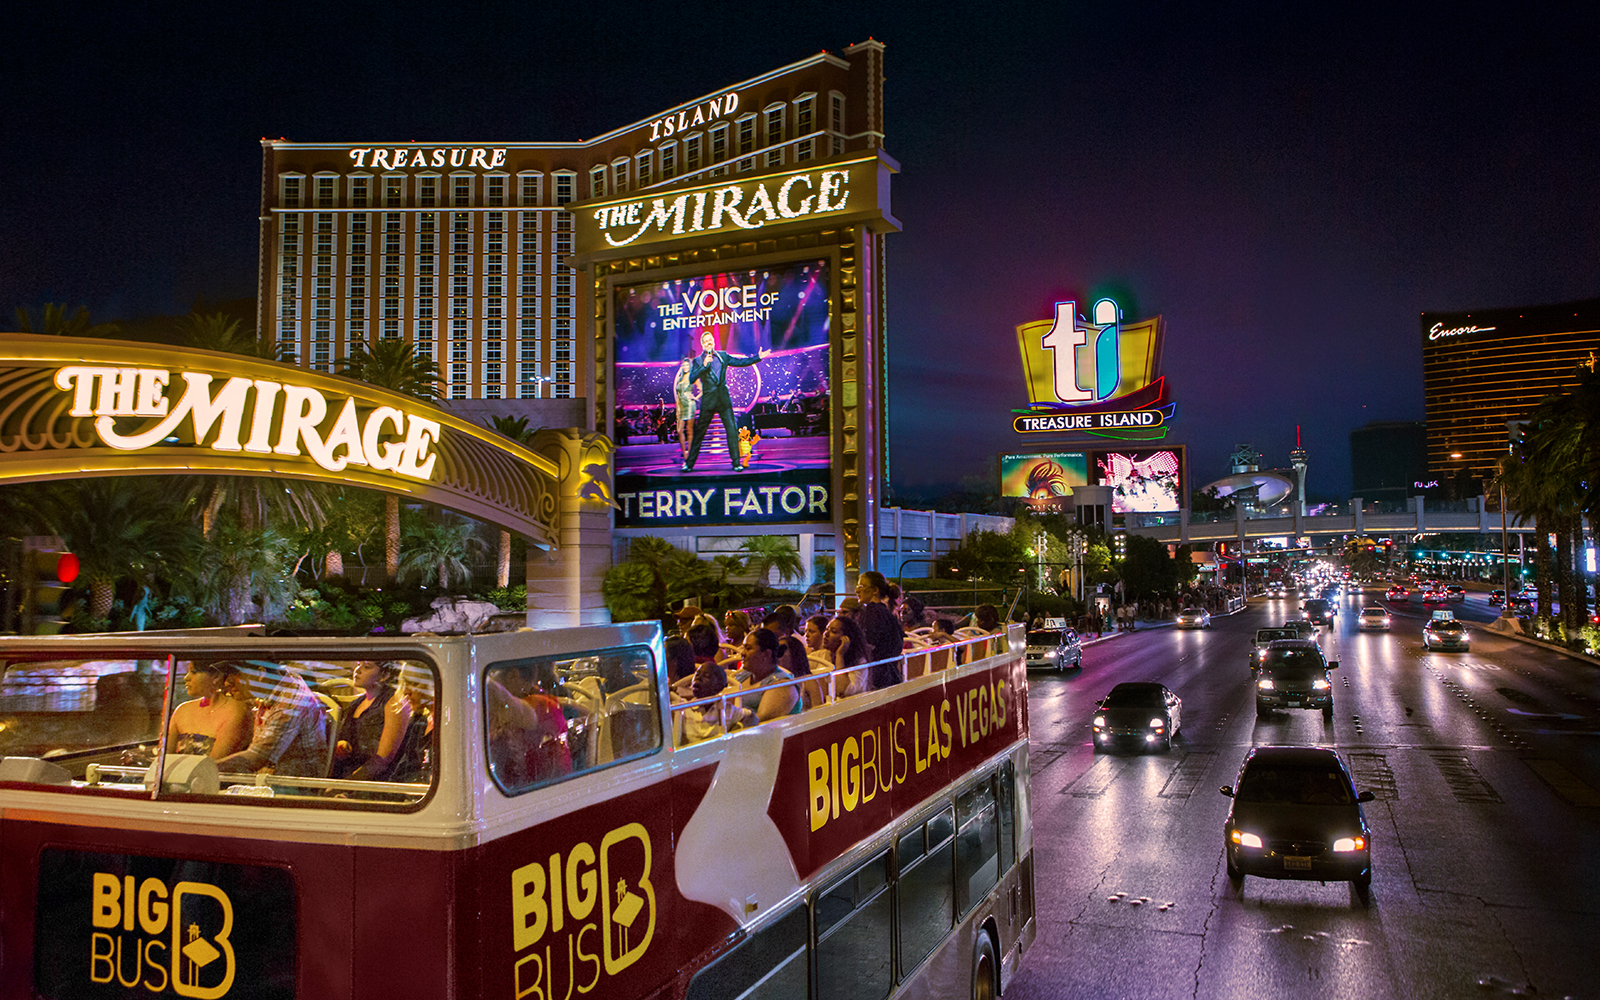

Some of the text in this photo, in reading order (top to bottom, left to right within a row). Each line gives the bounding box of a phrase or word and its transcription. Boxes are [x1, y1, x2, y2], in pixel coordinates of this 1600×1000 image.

[649, 92, 739, 141] ISLAND
[350, 148, 507, 169] TREASURE
[593, 170, 850, 246] THE MIRAGE
[657, 285, 779, 317] THE VOICE OF
[663, 307, 772, 331] ENTERTAINMENT
[1429, 322, 1497, 340] Encore
[54, 367, 440, 480] THE MIRAGE
[1023, 413, 1154, 430] TREASURE ISLAND
[618, 485, 828, 518] TERRY FATOR
[914, 699, 952, 774] LAS
[957, 679, 1006, 748] VEGAS
[93, 872, 169, 933] BIG
[512, 842, 598, 952] BIG
[91, 933, 167, 993] BUS
[514, 923, 600, 1000] BUS
